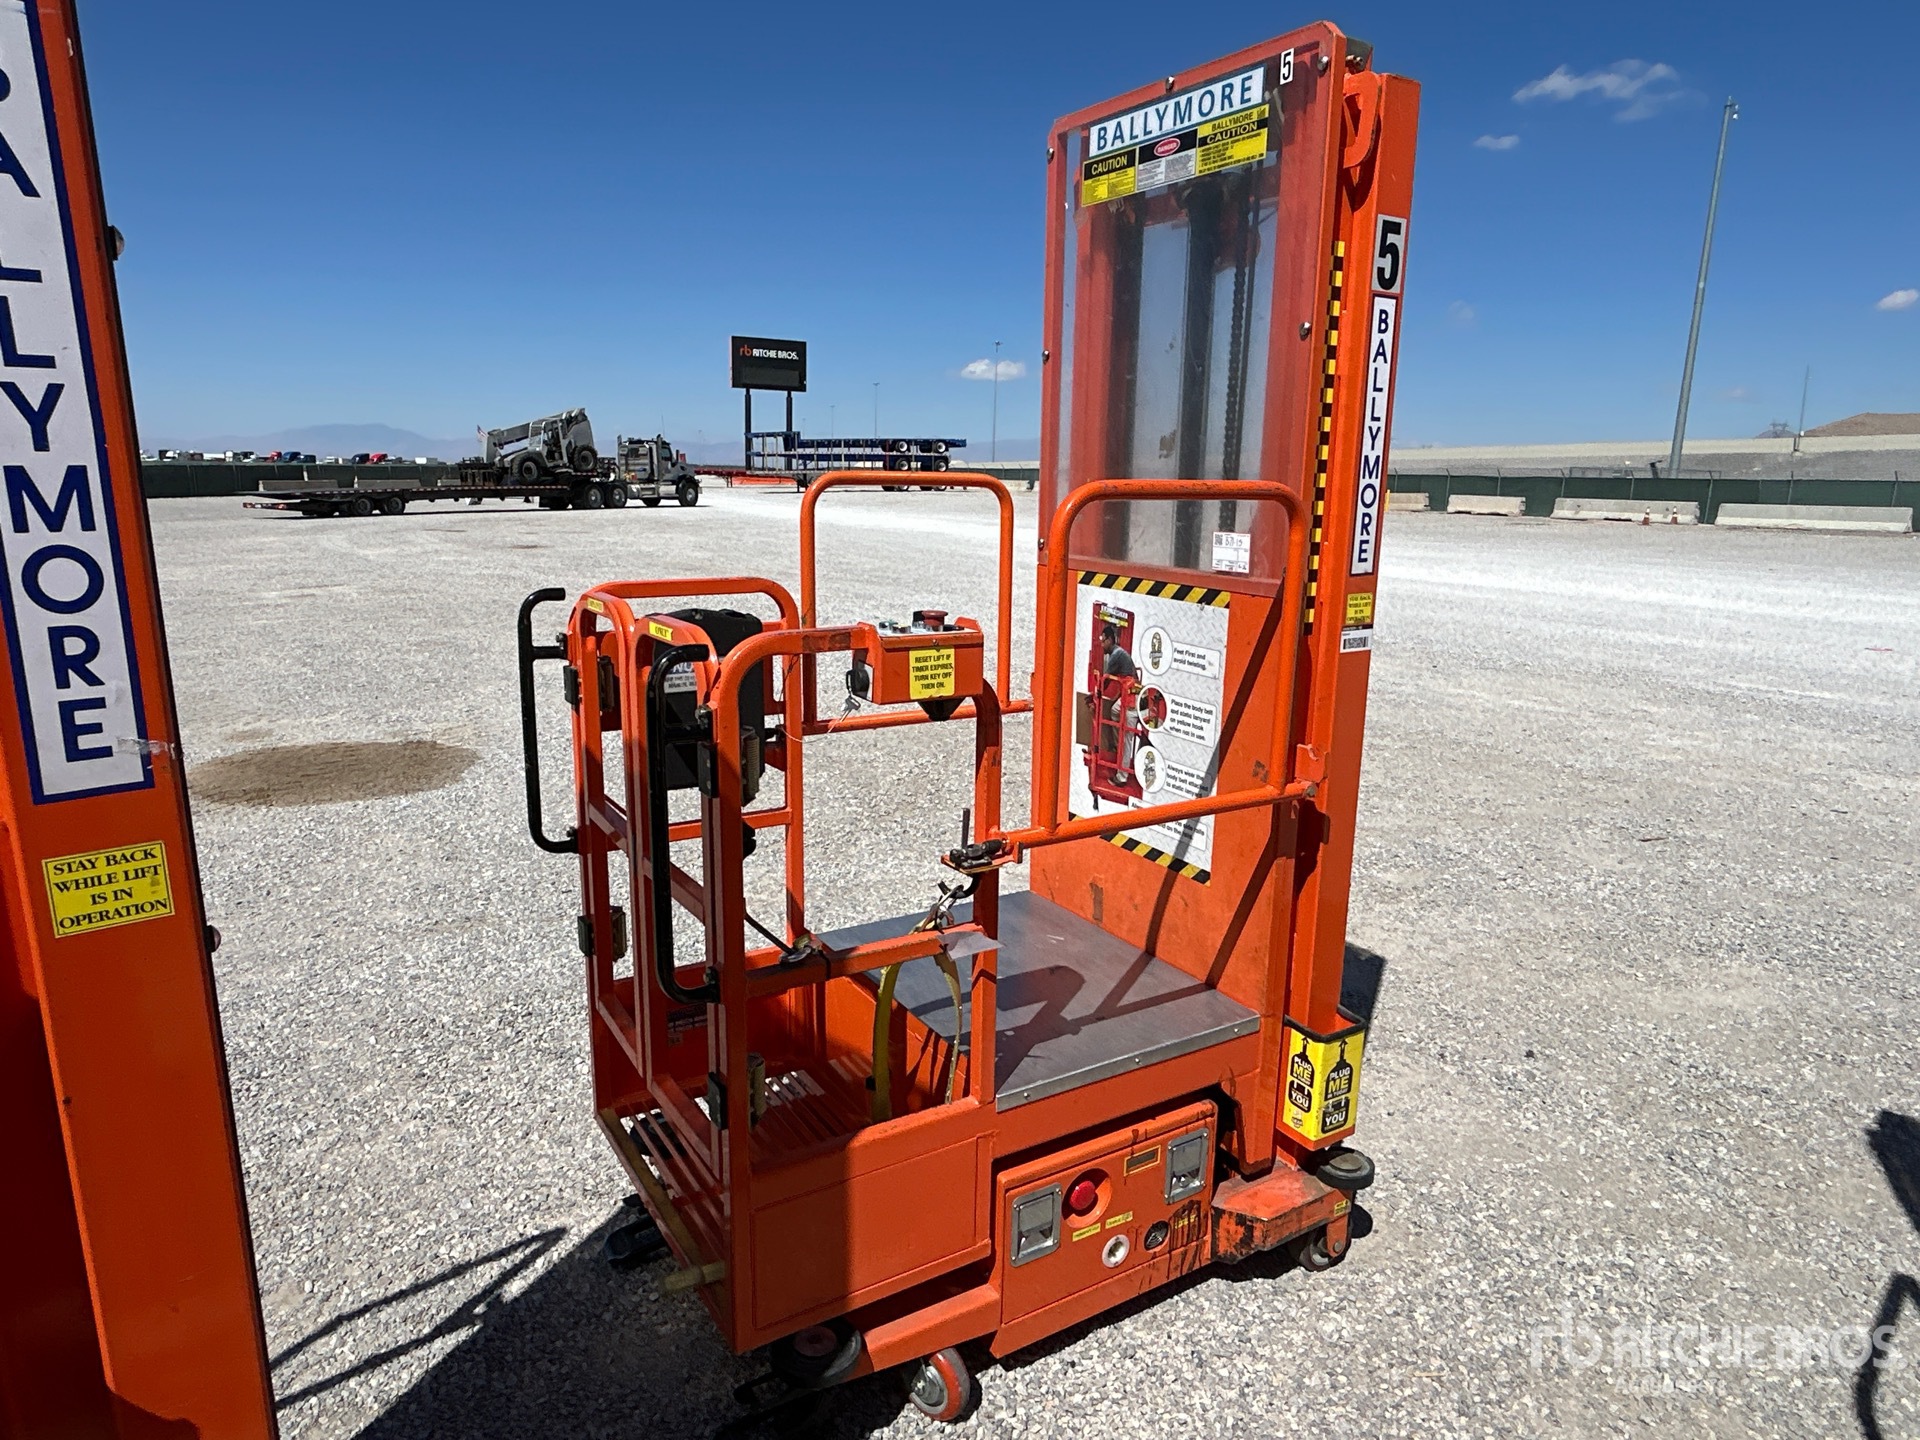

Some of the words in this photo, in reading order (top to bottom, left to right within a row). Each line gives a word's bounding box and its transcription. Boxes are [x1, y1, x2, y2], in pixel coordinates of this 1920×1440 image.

[1283, 51, 1291, 81] 5
[1097, 75, 1253, 151] BALLYMORE
[1212, 112, 1254, 132] BALLYMORE
[1207, 122, 1258, 144] CAUTION
[1091, 155, 1128, 175] CAUTION
[1376, 219, 1402, 291] 5
[752, 348, 777, 358] RITCHIE
[1357, 308, 1390, 563] BALLYMORE
[915, 656, 932, 664] RESET
[933, 654, 945, 662] LIFT
[912, 665, 929, 673] TIMER
[914, 674, 929, 682] TURN
[942, 671, 953, 679] OFF
[921, 682, 935, 690] THEN
[1171, 698, 1183, 707] Place
[1191, 705, 1203, 714] body
[1180, 711, 1192, 719] static
[1177, 719, 1191, 728] yellow
[1167, 764, 1183, 774] Always
[53, 857, 99, 876] STAY
[104, 847, 158, 867] BACK
[53, 871, 120, 893] WHILE
[122, 863, 162, 882] LIFT
[90, 892, 108, 906] IS
[111, 886, 134, 901] IN
[58, 898, 169, 929] OPERATION
[1293, 1062, 1311, 1080] ME
[1294, 1056, 1312, 1071] PLUG
[1330, 1067, 1350, 1081] PLUG
[1328, 1075, 1350, 1094] ME
[1291, 1090, 1309, 1108] YOU
[1325, 1110, 1346, 1126] YOU
